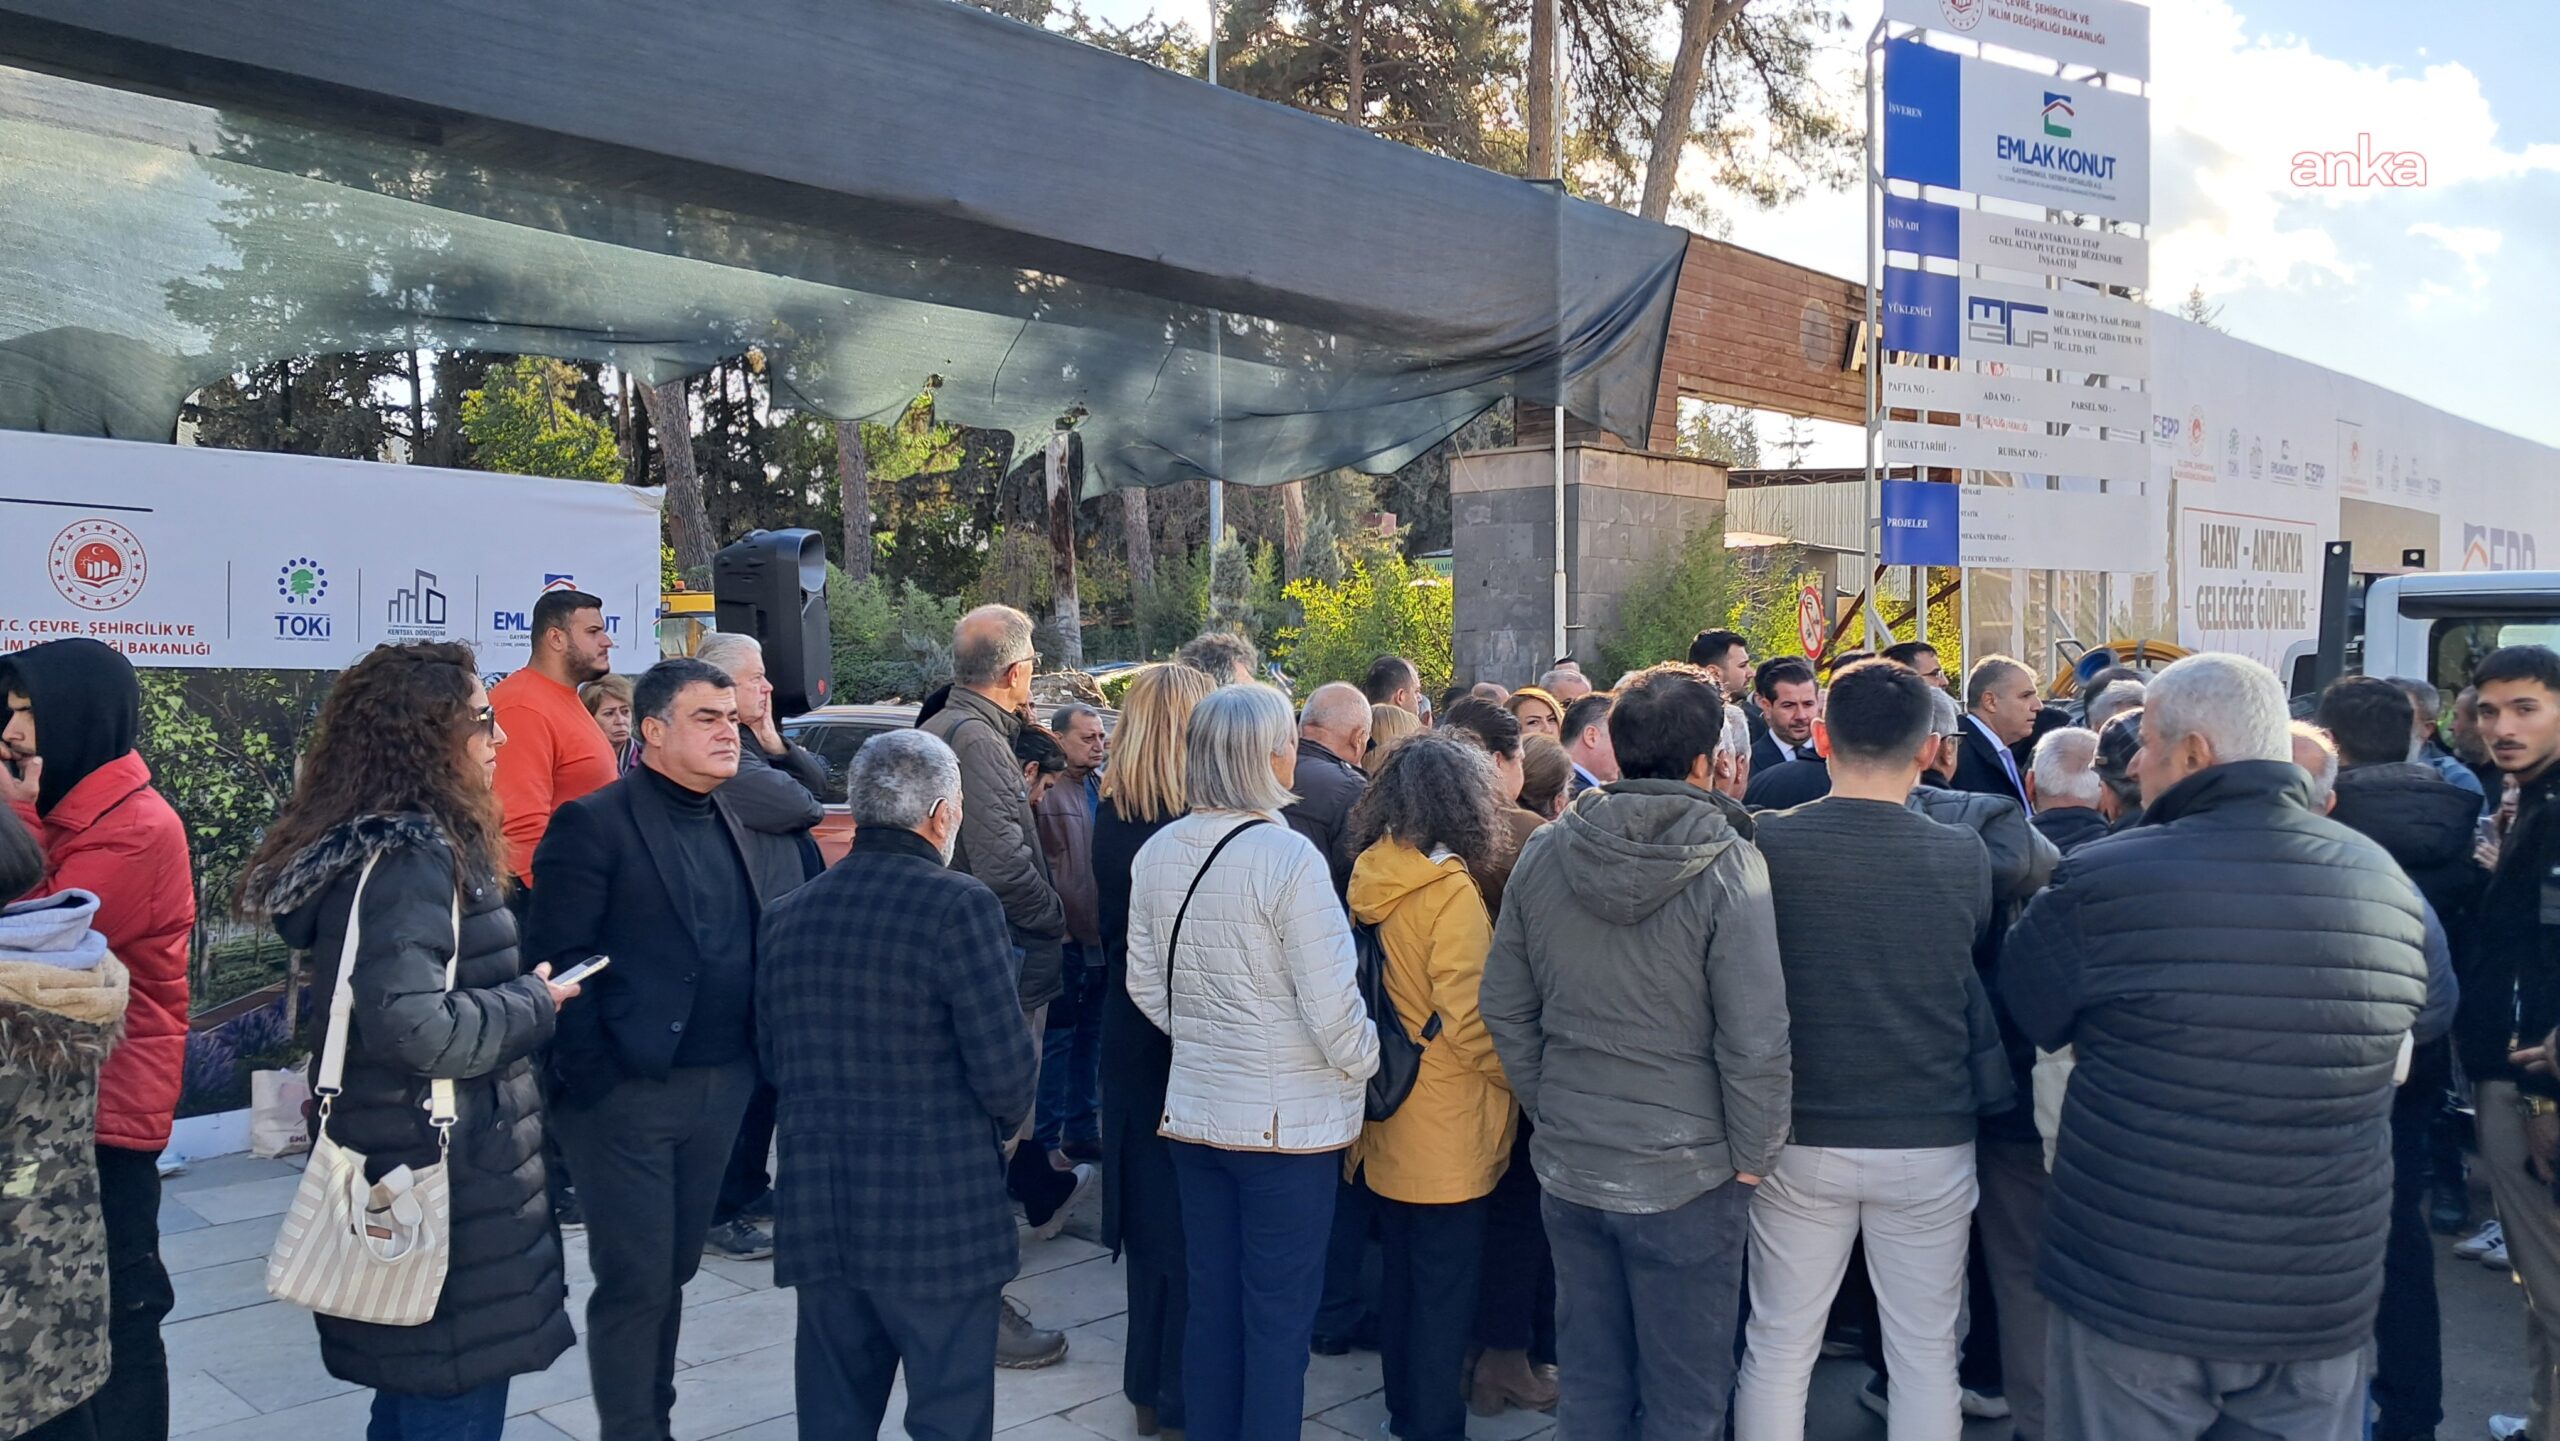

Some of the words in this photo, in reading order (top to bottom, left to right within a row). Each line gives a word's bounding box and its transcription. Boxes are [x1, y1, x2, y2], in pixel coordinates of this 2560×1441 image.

[1988, 6, 2011, 20] İKLİM
[2062, 25, 2105, 45] BAKANLIĞI
[2079, 14, 2090, 25] VE
[1888, 101, 1922, 118] İŞVEREN
[1997, 134, 2056, 169] EMLAK
[2058, 147, 2116, 180] KONUT
[1887, 216, 1904, 230] İŞİN
[1905, 219, 1919, 232] ADI
[2015, 227, 2037, 240] HATAY
[2039, 232, 2072, 244] ANTAKYA
[2082, 239, 2100, 249] ETAP
[1989, 235, 2014, 247] GENEL
[2014, 239, 2045, 251] ALTYAPI
[2045, 244, 2056, 254] VE
[2056, 246, 2080, 258] ÇEVRE
[2081, 249, 2123, 265] DÜZENLEME
[2038, 254, 2067, 268] İNŞAATI
[1887, 303, 1932, 318] YÜKLENİCİ
[2053, 309, 2065, 319] MR
[2065, 310, 2085, 321] GRUP
[2121, 317, 2142, 329] PROJE
[2072, 328, 2098, 340] YEMEK
[2098, 330, 2117, 341] GIDA
[2134, 335, 2143, 346] VE
[2053, 340, 2068, 352] TİC.
[2068, 343, 2083, 353] LTD.
[1888, 382, 1913, 393] PAFTA
[1913, 385, 1925, 393] NO
[1983, 392, 1999, 402] ADA
[2000, 393, 2011, 402] NO
[2071, 401, 2097, 412] PARSEL
[2097, 403, 2108, 413] NO
[1887, 438, 1920, 450] RUHSAT
[1920, 440, 1947, 452] TARİHİ
[1997, 446, 2026, 458] RUHSAT
[2027, 449, 2038, 458] NO
[1886, 517, 1928, 529] PROJELER
[2200, 522, 2240, 570] HATAY
[2252, 528, 2303, 574] ANTAKYA
[2196, 579, 2255, 631] GELECEĞE
[2257, 579, 2307, 631] GÜVENLE
[29, 620, 84, 636] ÇEVRE,
[89, 620, 173, 637] ŞEHİRCİLİK
[177, 624, 195, 636] VE
[387, 628, 413, 636] KENTSEL
[415, 629, 446, 637] DÖNÜŞÜM
[128, 641, 211, 656] BAKANLIĞI
